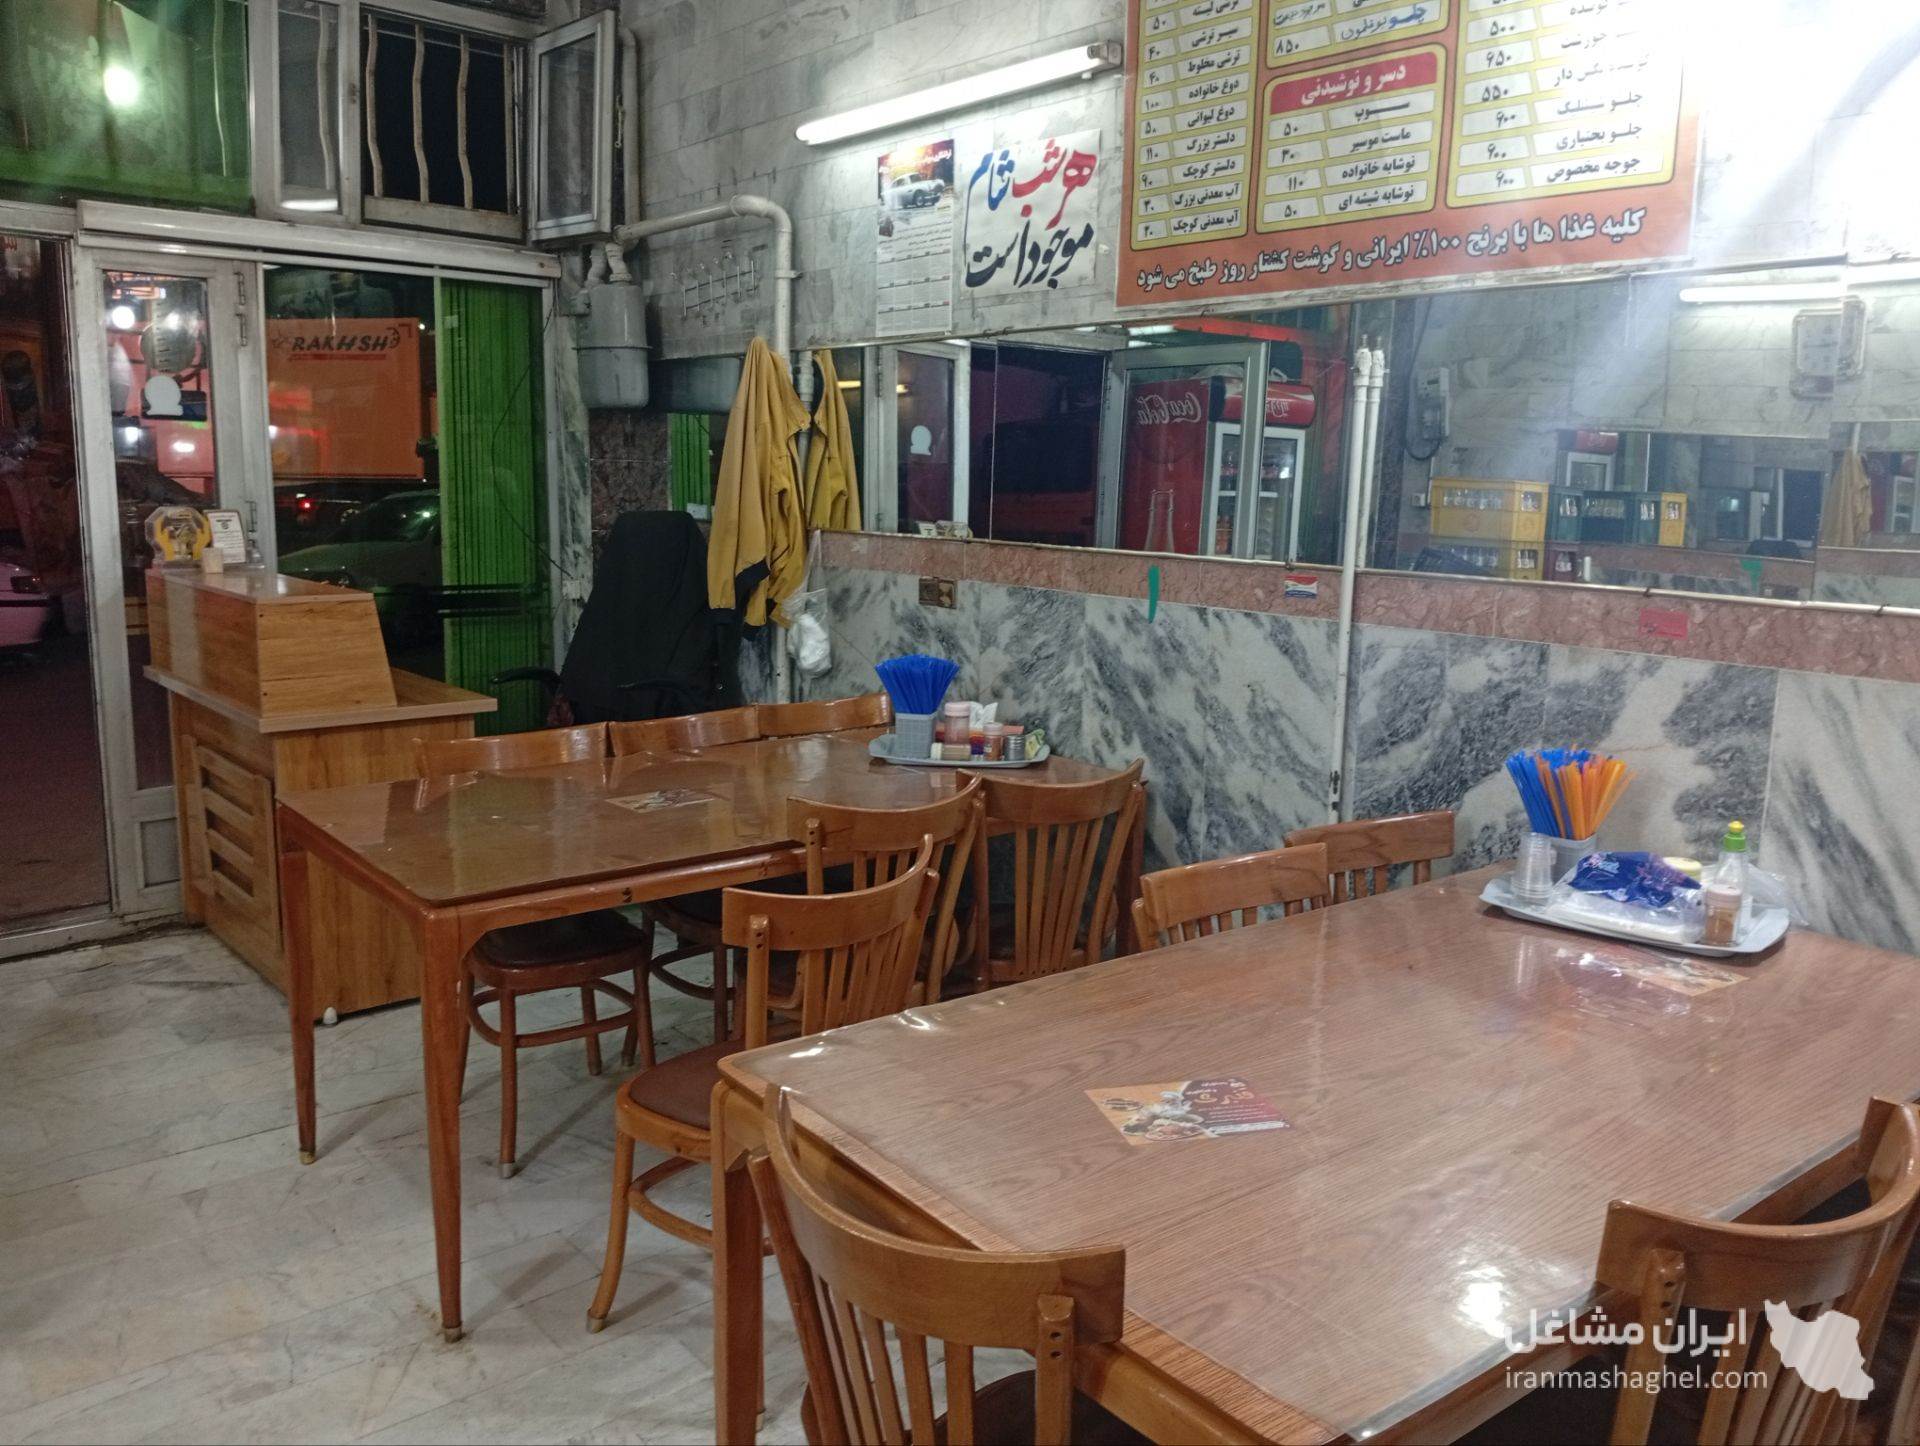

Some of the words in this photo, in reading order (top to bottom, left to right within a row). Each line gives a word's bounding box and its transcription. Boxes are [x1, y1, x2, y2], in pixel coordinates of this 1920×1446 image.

[1489, 20, 1516, 36] ۵۰۰
[1192, 28, 1215, 47] ترشی
[1276, 39, 1299, 54] ۸۵۰
[1188, 57, 1215, 75] مخلوط
[1217, 50, 1240, 68] ترشی
[1363, 75, 1372, 93] و
[1375, 64, 1407, 91] دسر
[1189, 82, 1220, 99] خانواده
[1221, 79, 1239, 95] دوغ
[1300, 70, 1360, 105] نوشیدنی
[1482, 84, 1509, 102] ۵۵۰
[1187, 109, 1214, 127] لیوانی
[1217, 106, 1235, 122] دوغ
[1284, 122, 1298, 137] ۵۰
[1381, 128, 1411, 143] ماست
[1187, 138, 1210, 152] بزرگ
[1212, 132, 1236, 150] دلستر
[1350, 136, 1379, 153] موسیر
[1183, 162, 1210, 179] کوچک
[1211, 159, 1235, 176] دلستر
[1342, 161, 1379, 180] خانواده
[1382, 156, 1415, 175] نوشابه
[1546, 160, 1600, 183] مخصوص
[1604, 158, 1641, 174] جوجه
[1012, 138, 1067, 217] شب
[1288, 176, 1303, 191] ۱۱۰
[1045, 150, 1097, 230] هر
[1197, 189, 1223, 205] معدنی
[1225, 183, 1241, 199] آب
[1354, 190, 1379, 206] شیشه
[1382, 185, 1414, 203] نوشابه
[964, 150, 1015, 267] شام
[1174, 193, 1195, 207] بزرگ
[1338, 195, 1352, 211] ای
[1226, 210, 1240, 226] آب
[1284, 204, 1297, 218] ۵۰
[1173, 217, 1198, 233] کوچک
[1200, 215, 1225, 230] معدنی
[1533, 217, 1554, 245] ها
[1560, 213, 1597, 242] غذا
[1600, 207, 1647, 243] کلیه
[1466, 224, 1508, 258] برنج
[1513, 220, 1529, 251] با
[965, 220, 1030, 288] است
[1018, 222, 1094, 289] موجود
[1292, 244, 1341, 274] گوشت
[1343, 250, 1354, 270] و
[1356, 234, 1410, 271] ایرانی
[1188, 258, 1217, 286] طبخ
[1220, 258, 1247, 283] روز
[1249, 249, 1290, 280] کشتار
[1137, 265, 1163, 291] شود
[1164, 270, 1186, 289] می
[292, 335, 388, 352] RAKHSH
